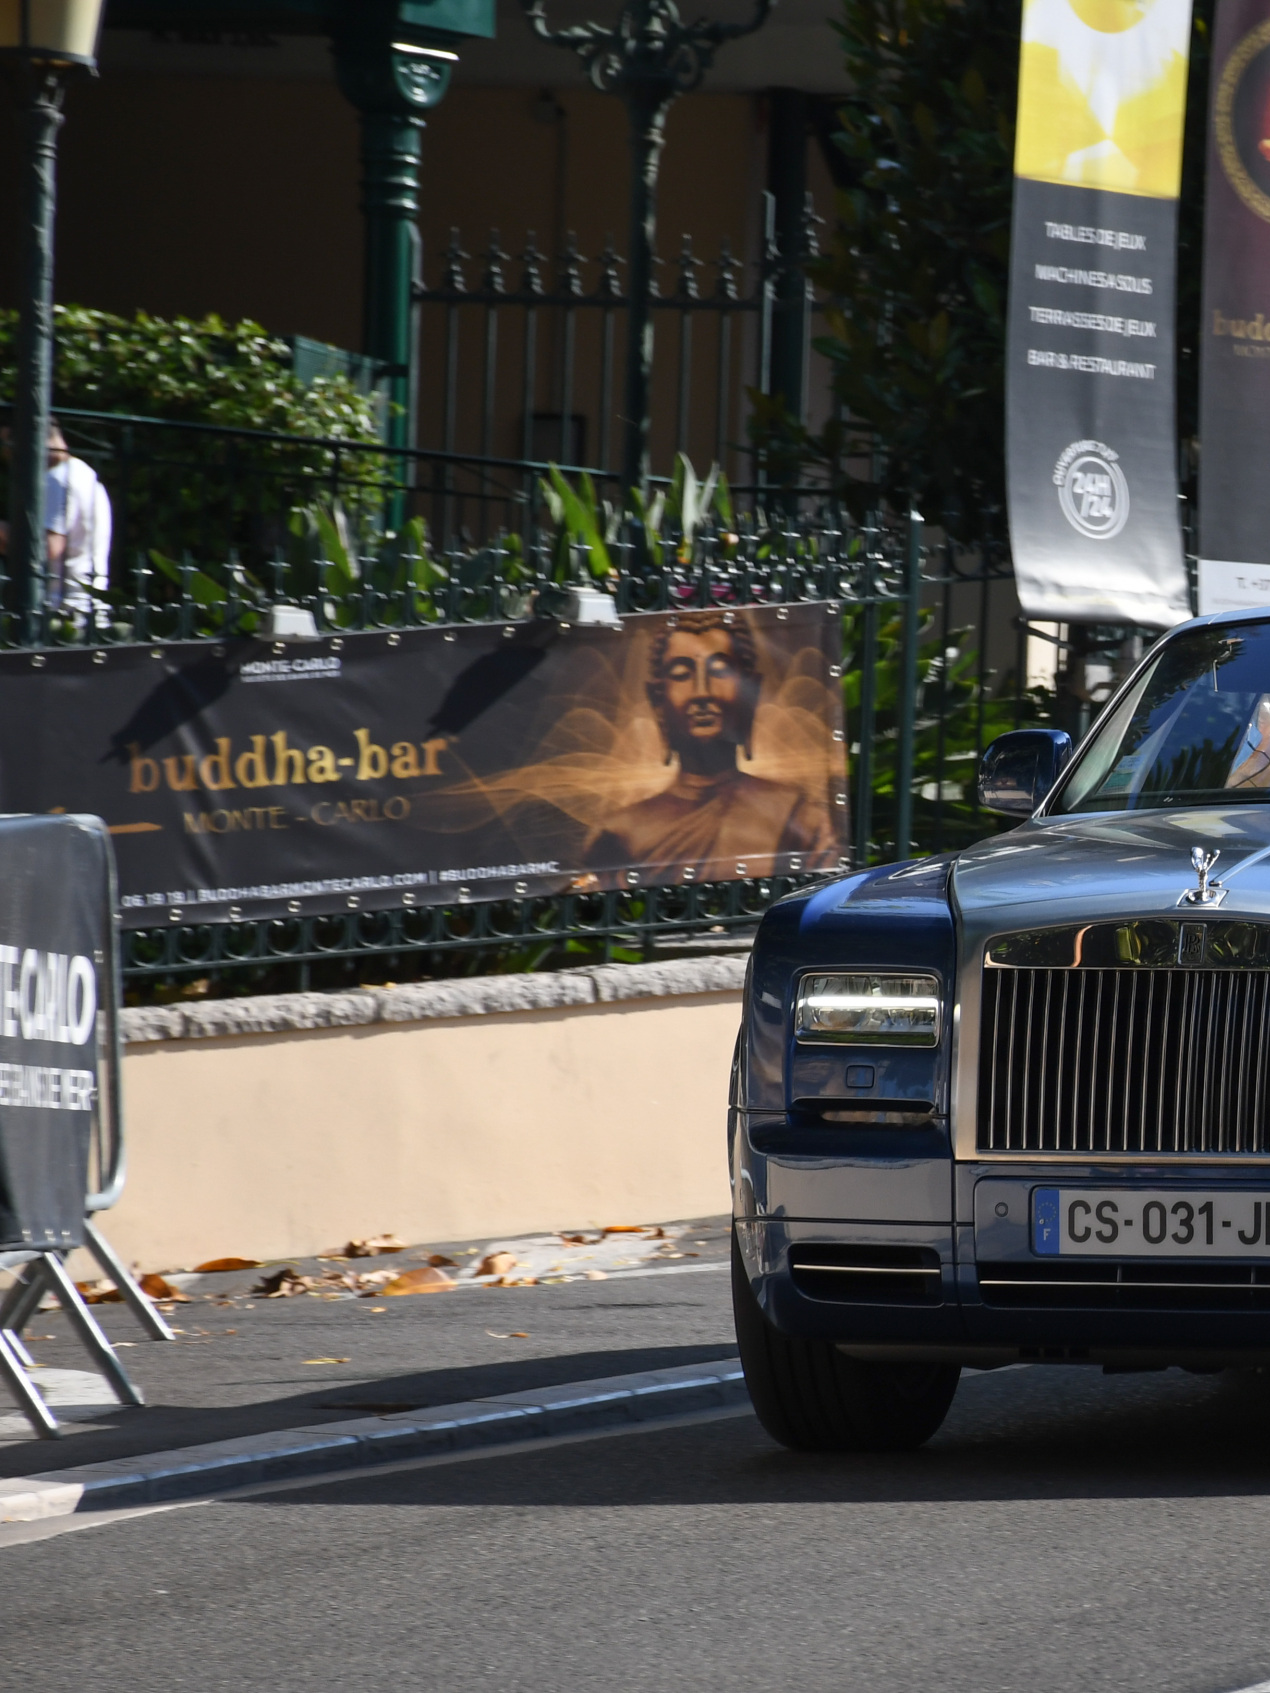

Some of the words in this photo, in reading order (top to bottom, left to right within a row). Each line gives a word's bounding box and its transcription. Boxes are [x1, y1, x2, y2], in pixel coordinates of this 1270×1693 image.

[1045, 221, 1096, 244] TABLES
[1096, 228, 1116, 246] DE
[1113, 231, 1146, 251] JEUX
[1035, 263, 1107, 288] MACHINES
[1115, 276, 1153, 294] SOUS
[1028, 306, 1106, 331] TERRASSES
[1104, 316, 1123, 333] DE
[1121, 319, 1157, 338] JEUX
[1027, 349, 1057, 367] BAR
[1068, 354, 1157, 379] RESTAURANT
[240, 656, 342, 675] MONTE-CARLO
[128, 728, 448, 794] buddha-bar
[438, 860, 560, 883] #BUDDHABARMC
[1043, 1228, 1051, 1241] F
